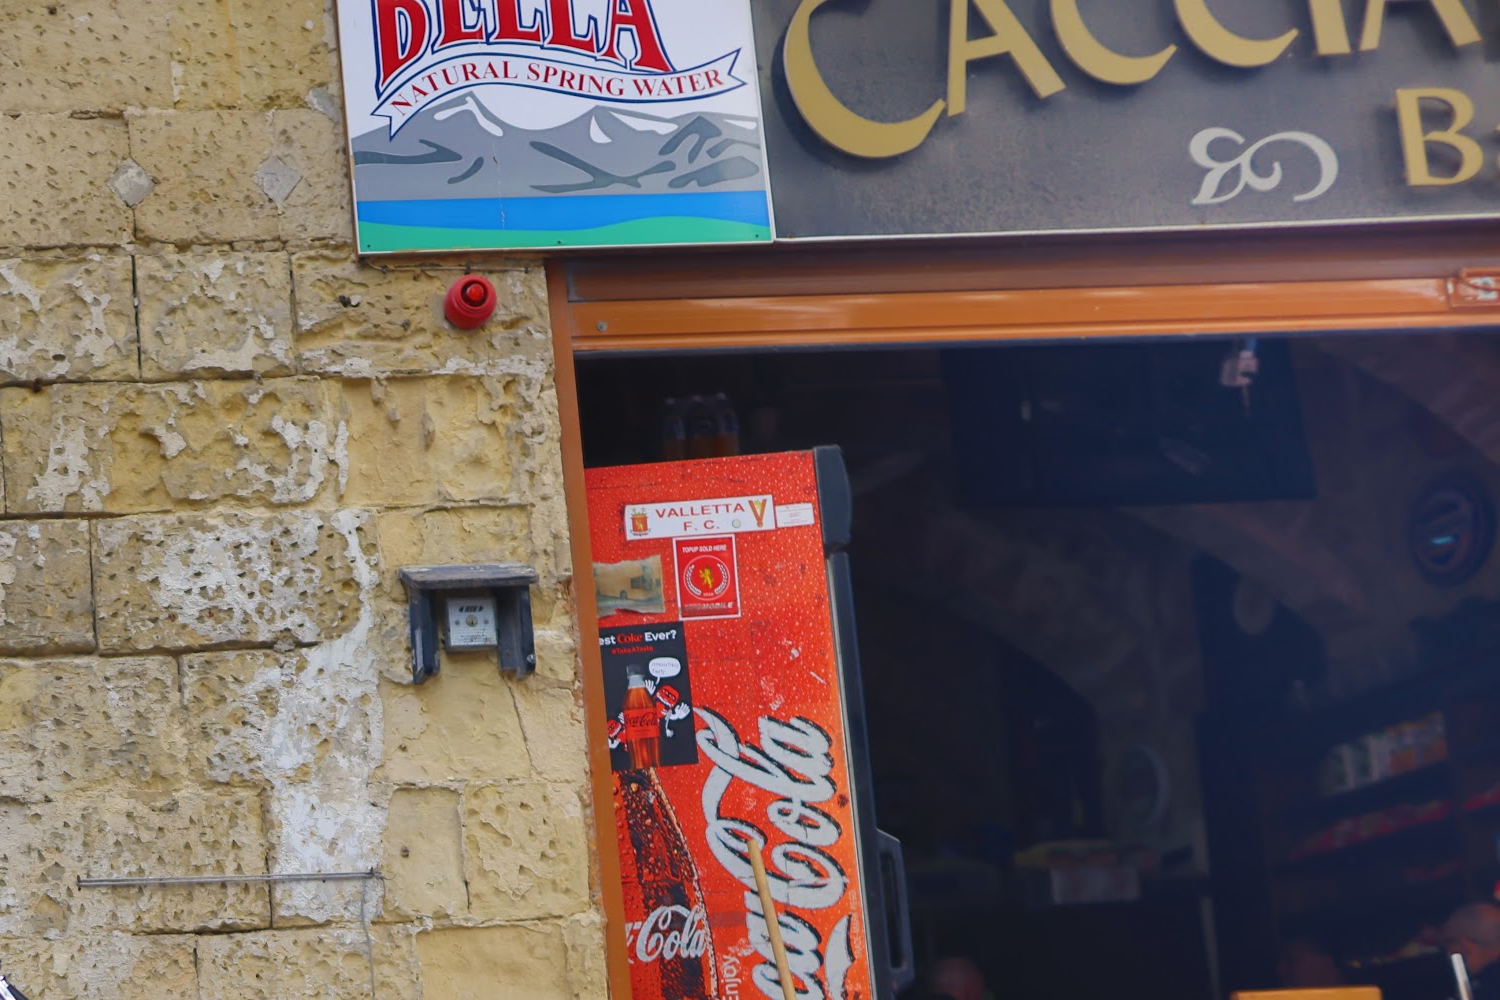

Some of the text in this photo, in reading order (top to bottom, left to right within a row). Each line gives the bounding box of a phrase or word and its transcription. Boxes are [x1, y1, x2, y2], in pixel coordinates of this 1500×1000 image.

[390, 60, 725, 116] NATURAL SPRING WATER
[655, 503, 745, 519] VALLETTA
[598, 629, 677, 646] est Coke Ever?
